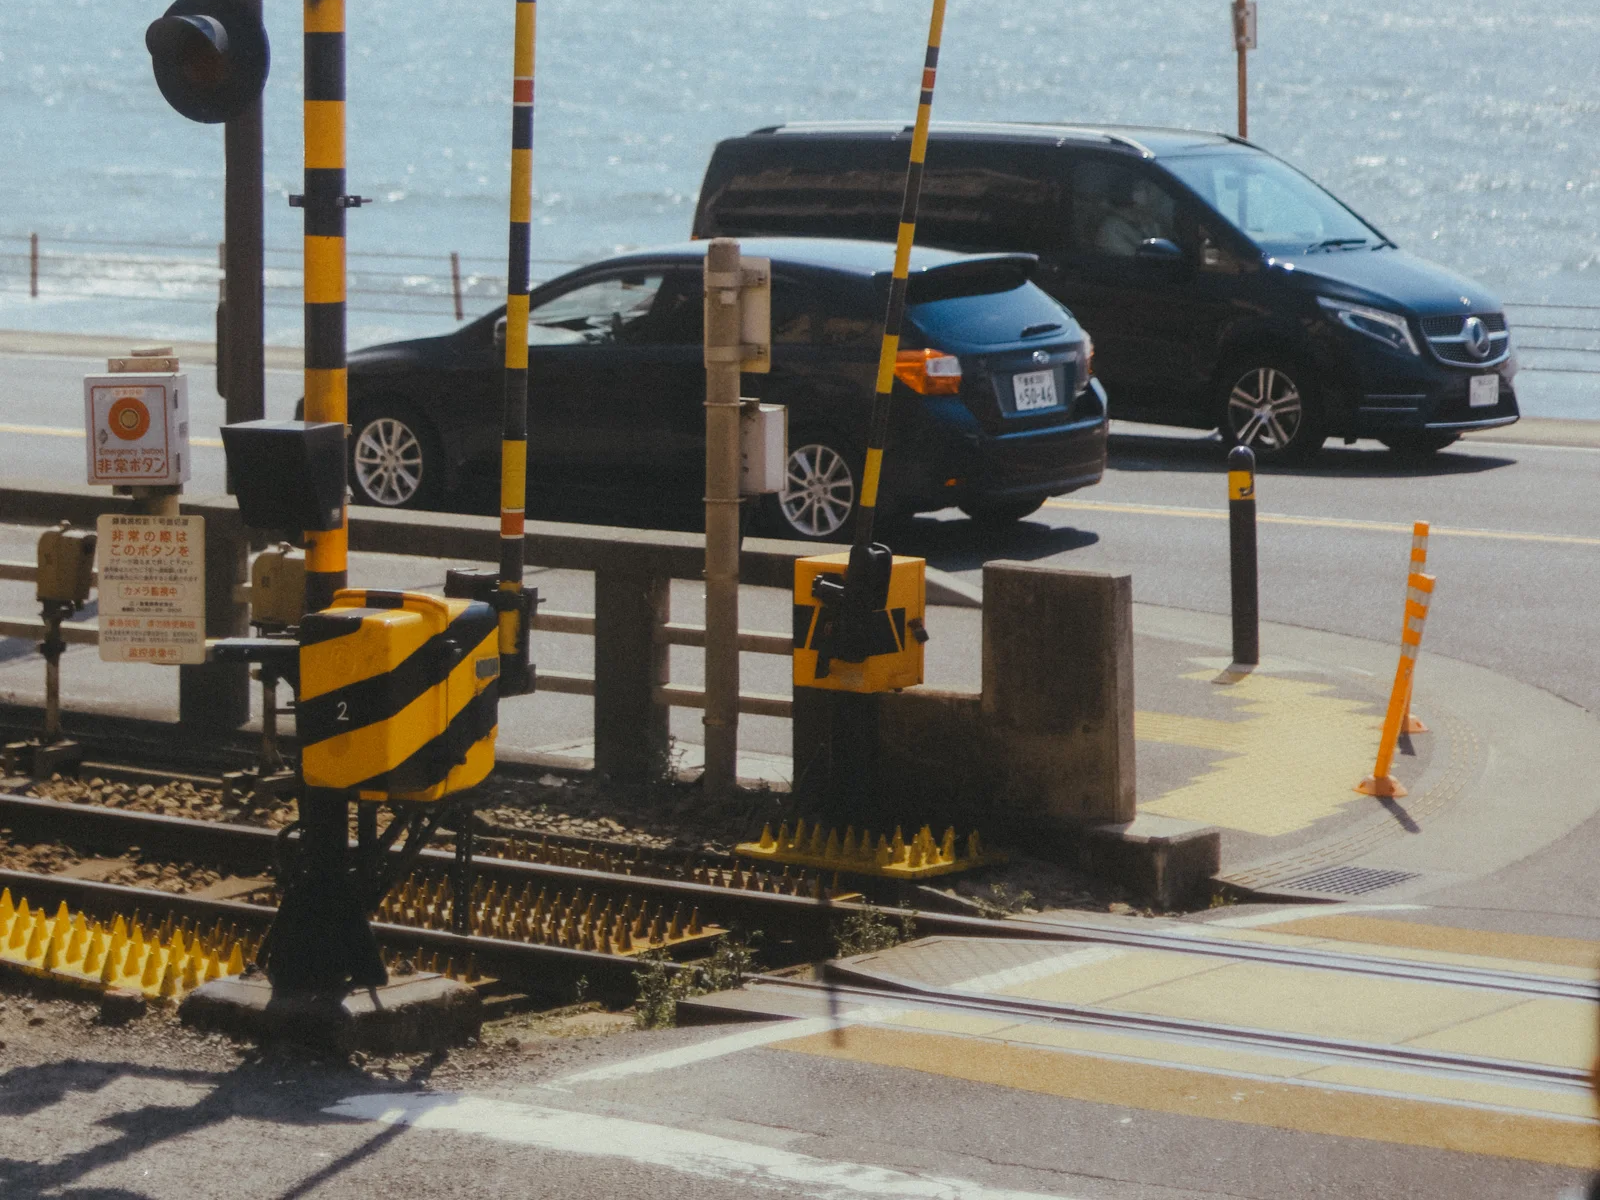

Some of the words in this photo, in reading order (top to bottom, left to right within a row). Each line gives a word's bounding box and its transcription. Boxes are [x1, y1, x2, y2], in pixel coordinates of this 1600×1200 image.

[99, 448, 138, 457] Emergency
[141, 447, 164, 455] button
[98, 458, 165, 473] 非常ボタン
[111, 529, 188, 543] 非常の際は
[110, 545, 190, 557] このボタンを
[124, 586, 178, 597] カメラ監視中
[336, 701, 349, 721] 2
